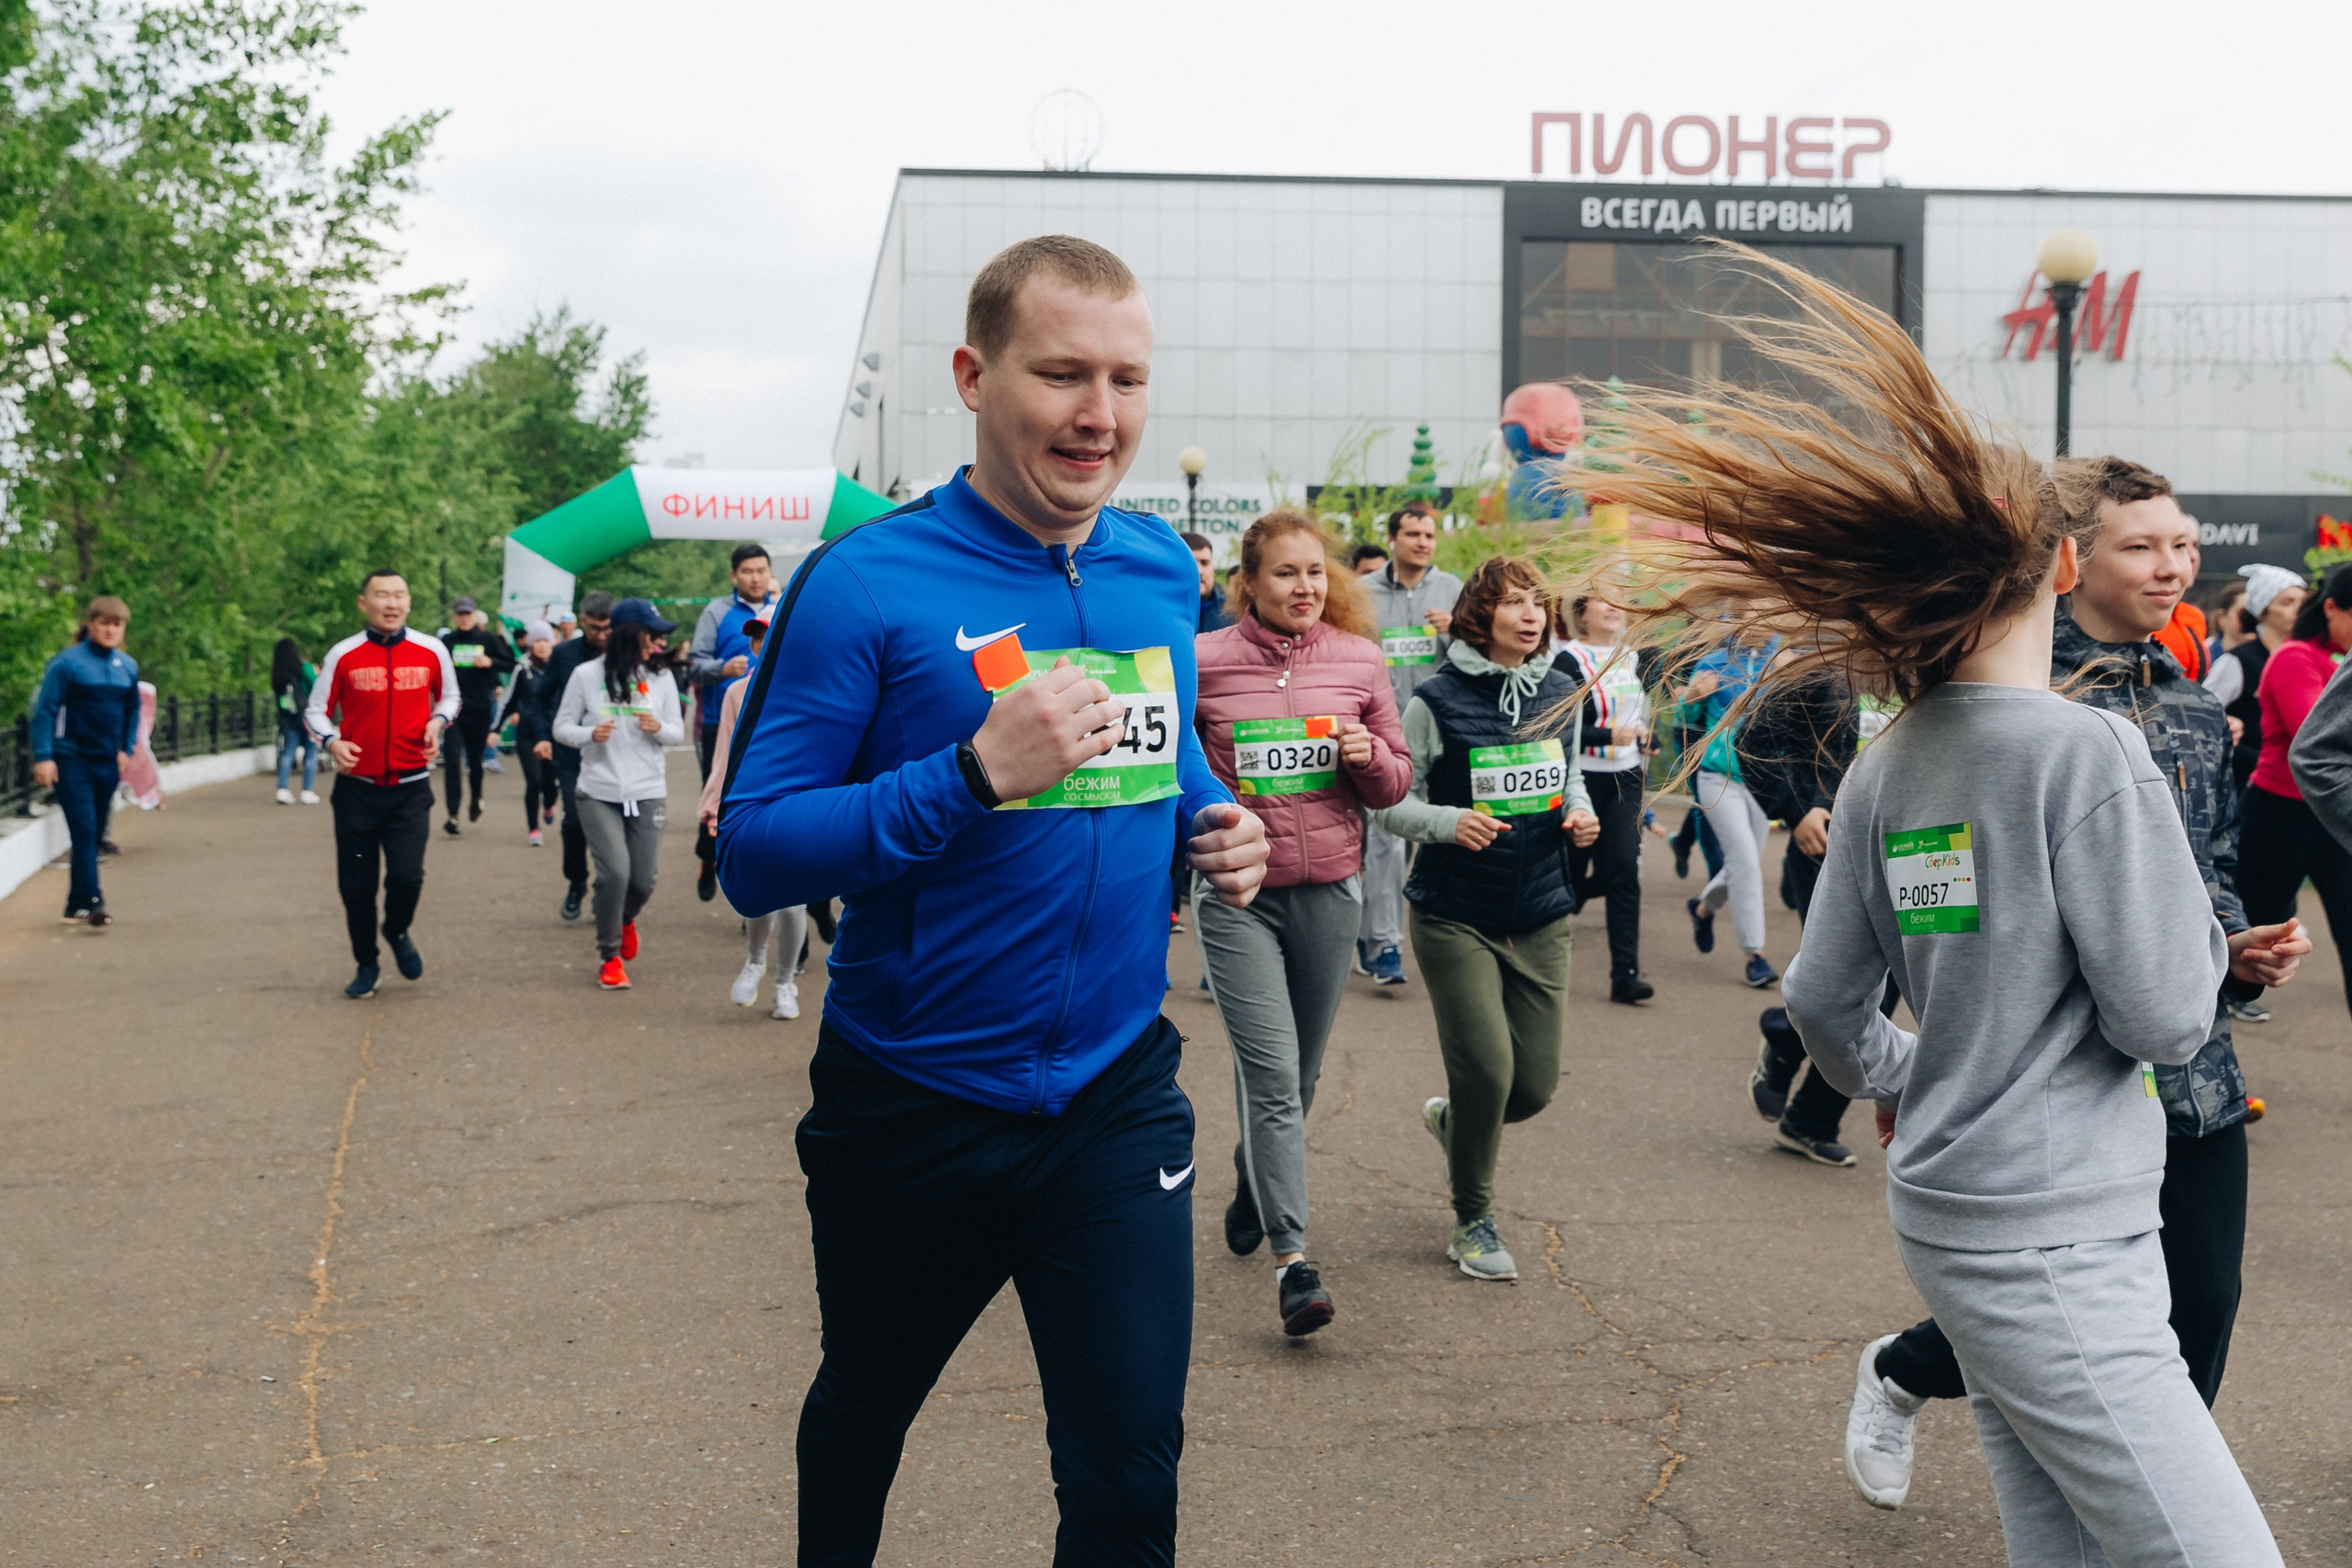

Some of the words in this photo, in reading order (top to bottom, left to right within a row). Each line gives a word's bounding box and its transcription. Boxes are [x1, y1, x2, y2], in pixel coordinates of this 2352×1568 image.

[1532, 112, 1891, 178] ПИОНЕР
[1580, 196, 1706, 233] ВСЕГДА
[1714, 193, 1854, 232] ПЕРВЫЙ
[2001, 268, 2141, 361] HM
[662, 493, 809, 520] ФИНИШ
[1091, 705, 1167, 756] 45
[1268, 745, 1330, 771] 0320
[1063, 773, 1120, 791] бежим
[1504, 766, 1560, 793] 0269
[1910, 912, 1935, 924] бежим
